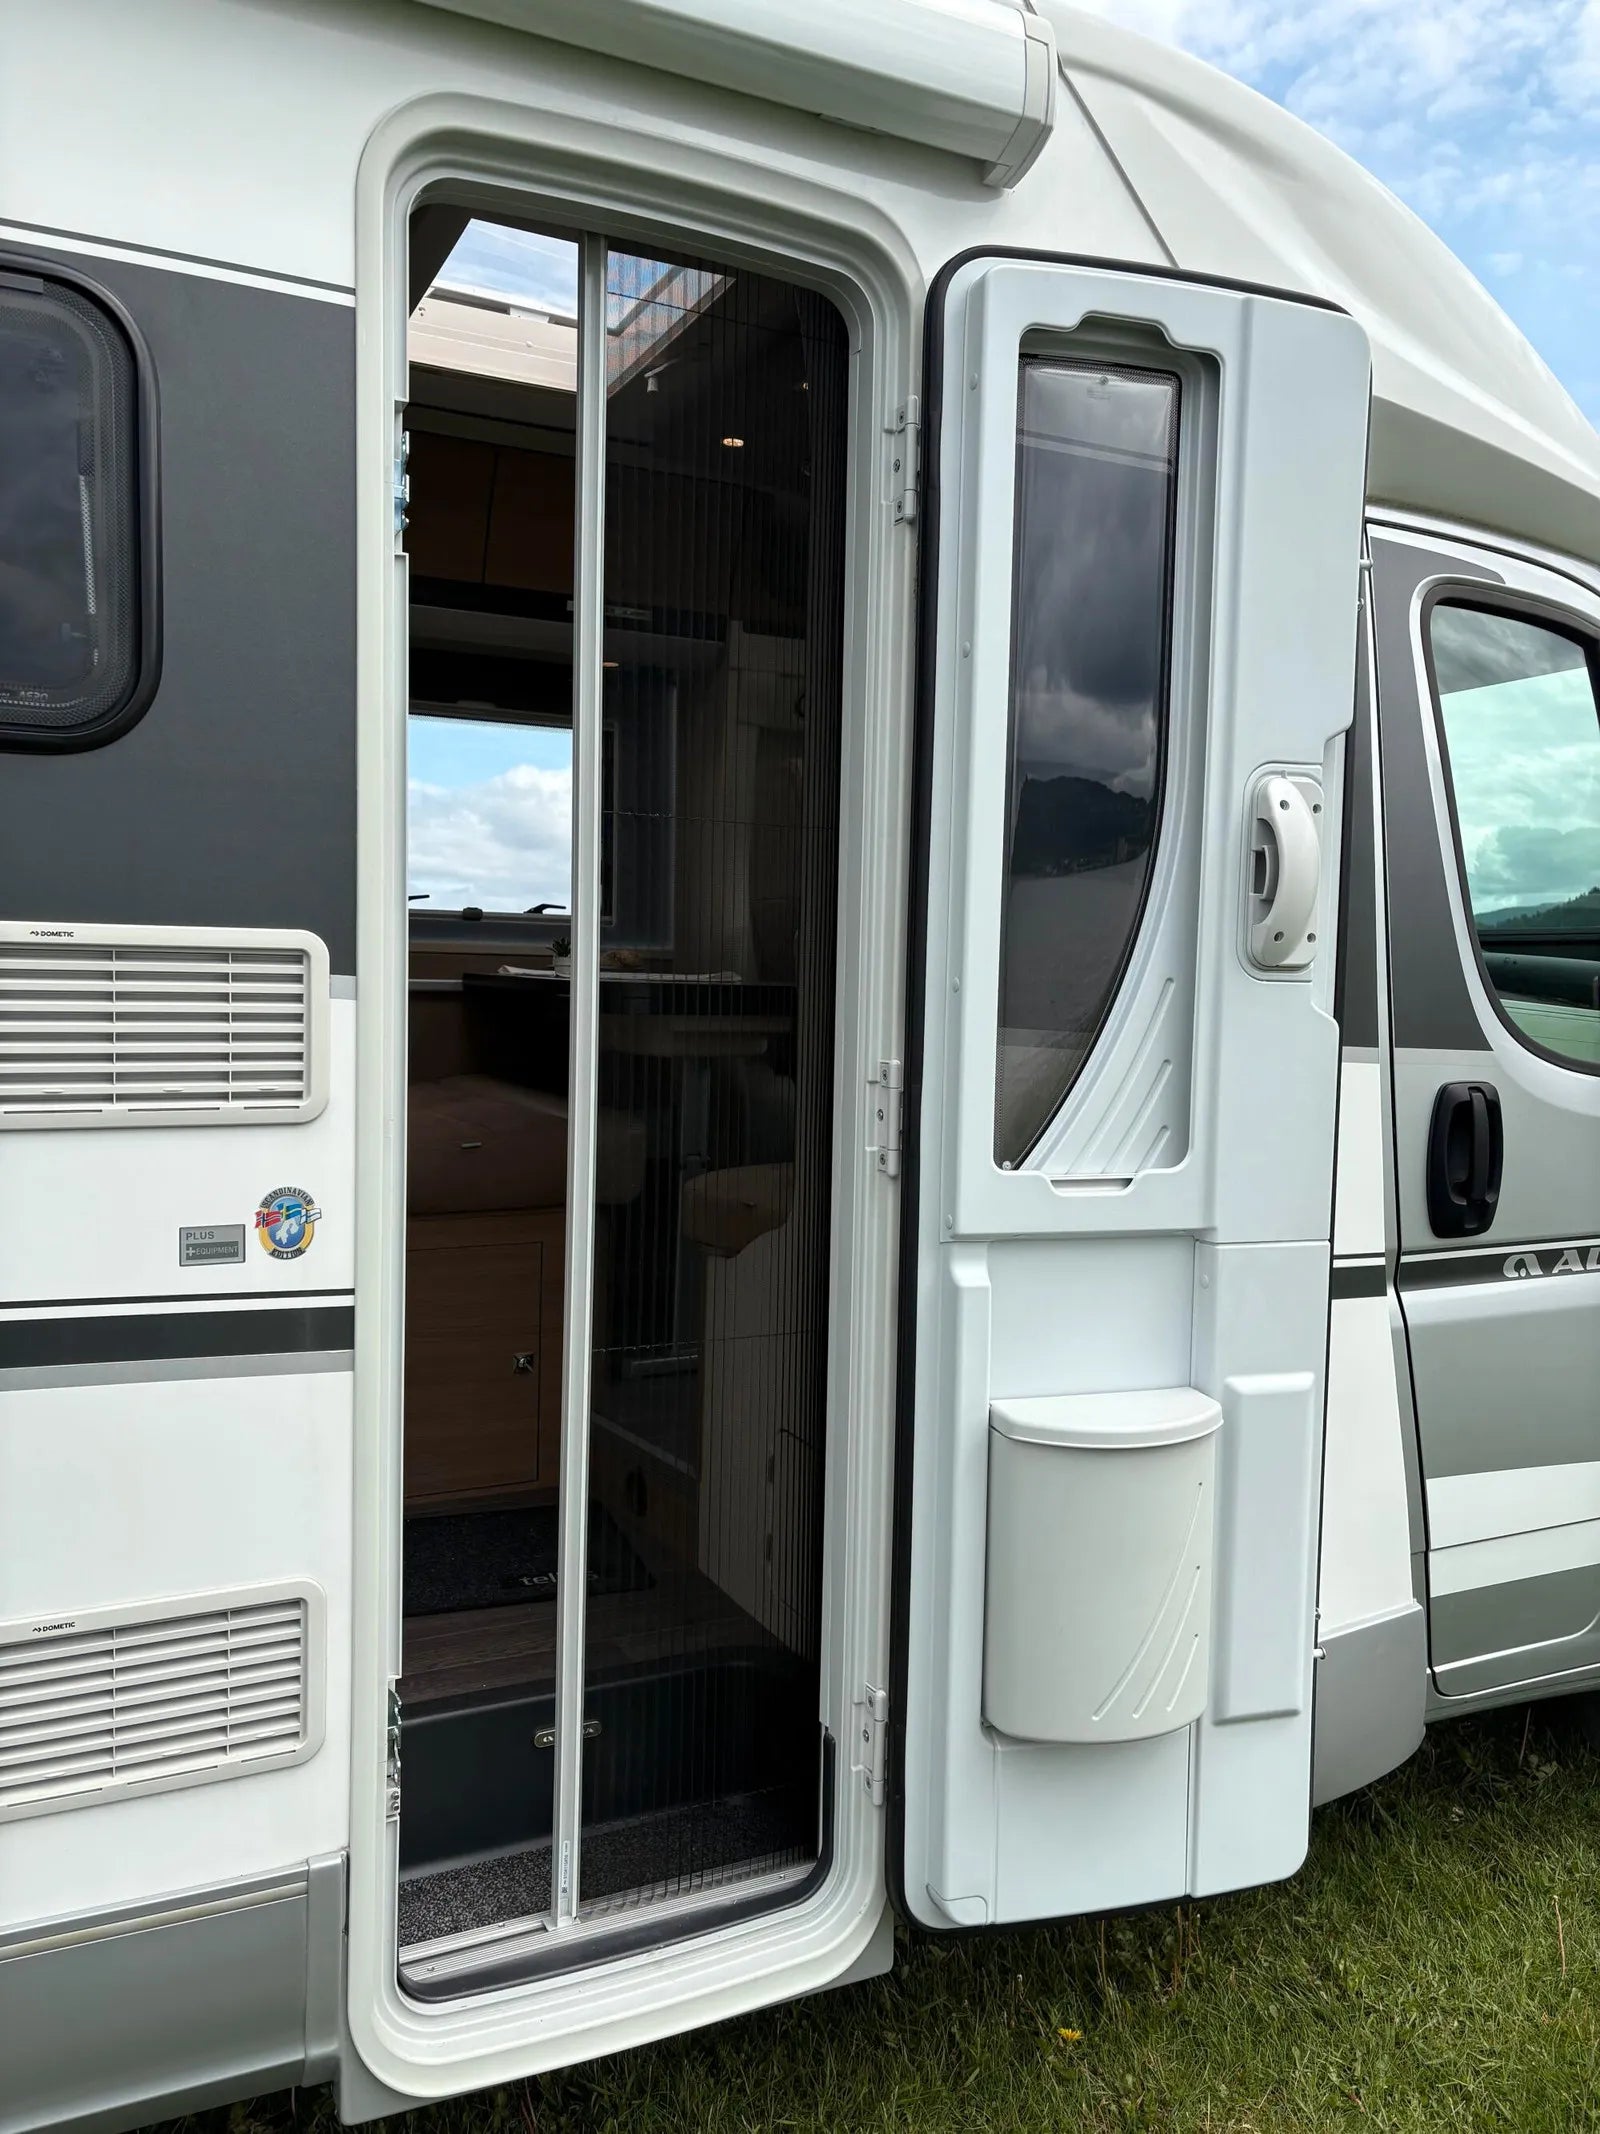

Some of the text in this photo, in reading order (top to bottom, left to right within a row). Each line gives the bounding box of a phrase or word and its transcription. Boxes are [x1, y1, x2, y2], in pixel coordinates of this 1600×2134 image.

[261, 1187, 315, 1209] SCANDINAVIAN
[186, 1231, 215, 1240] PLUS
[42, 1621, 76, 1632] DOMETIC
